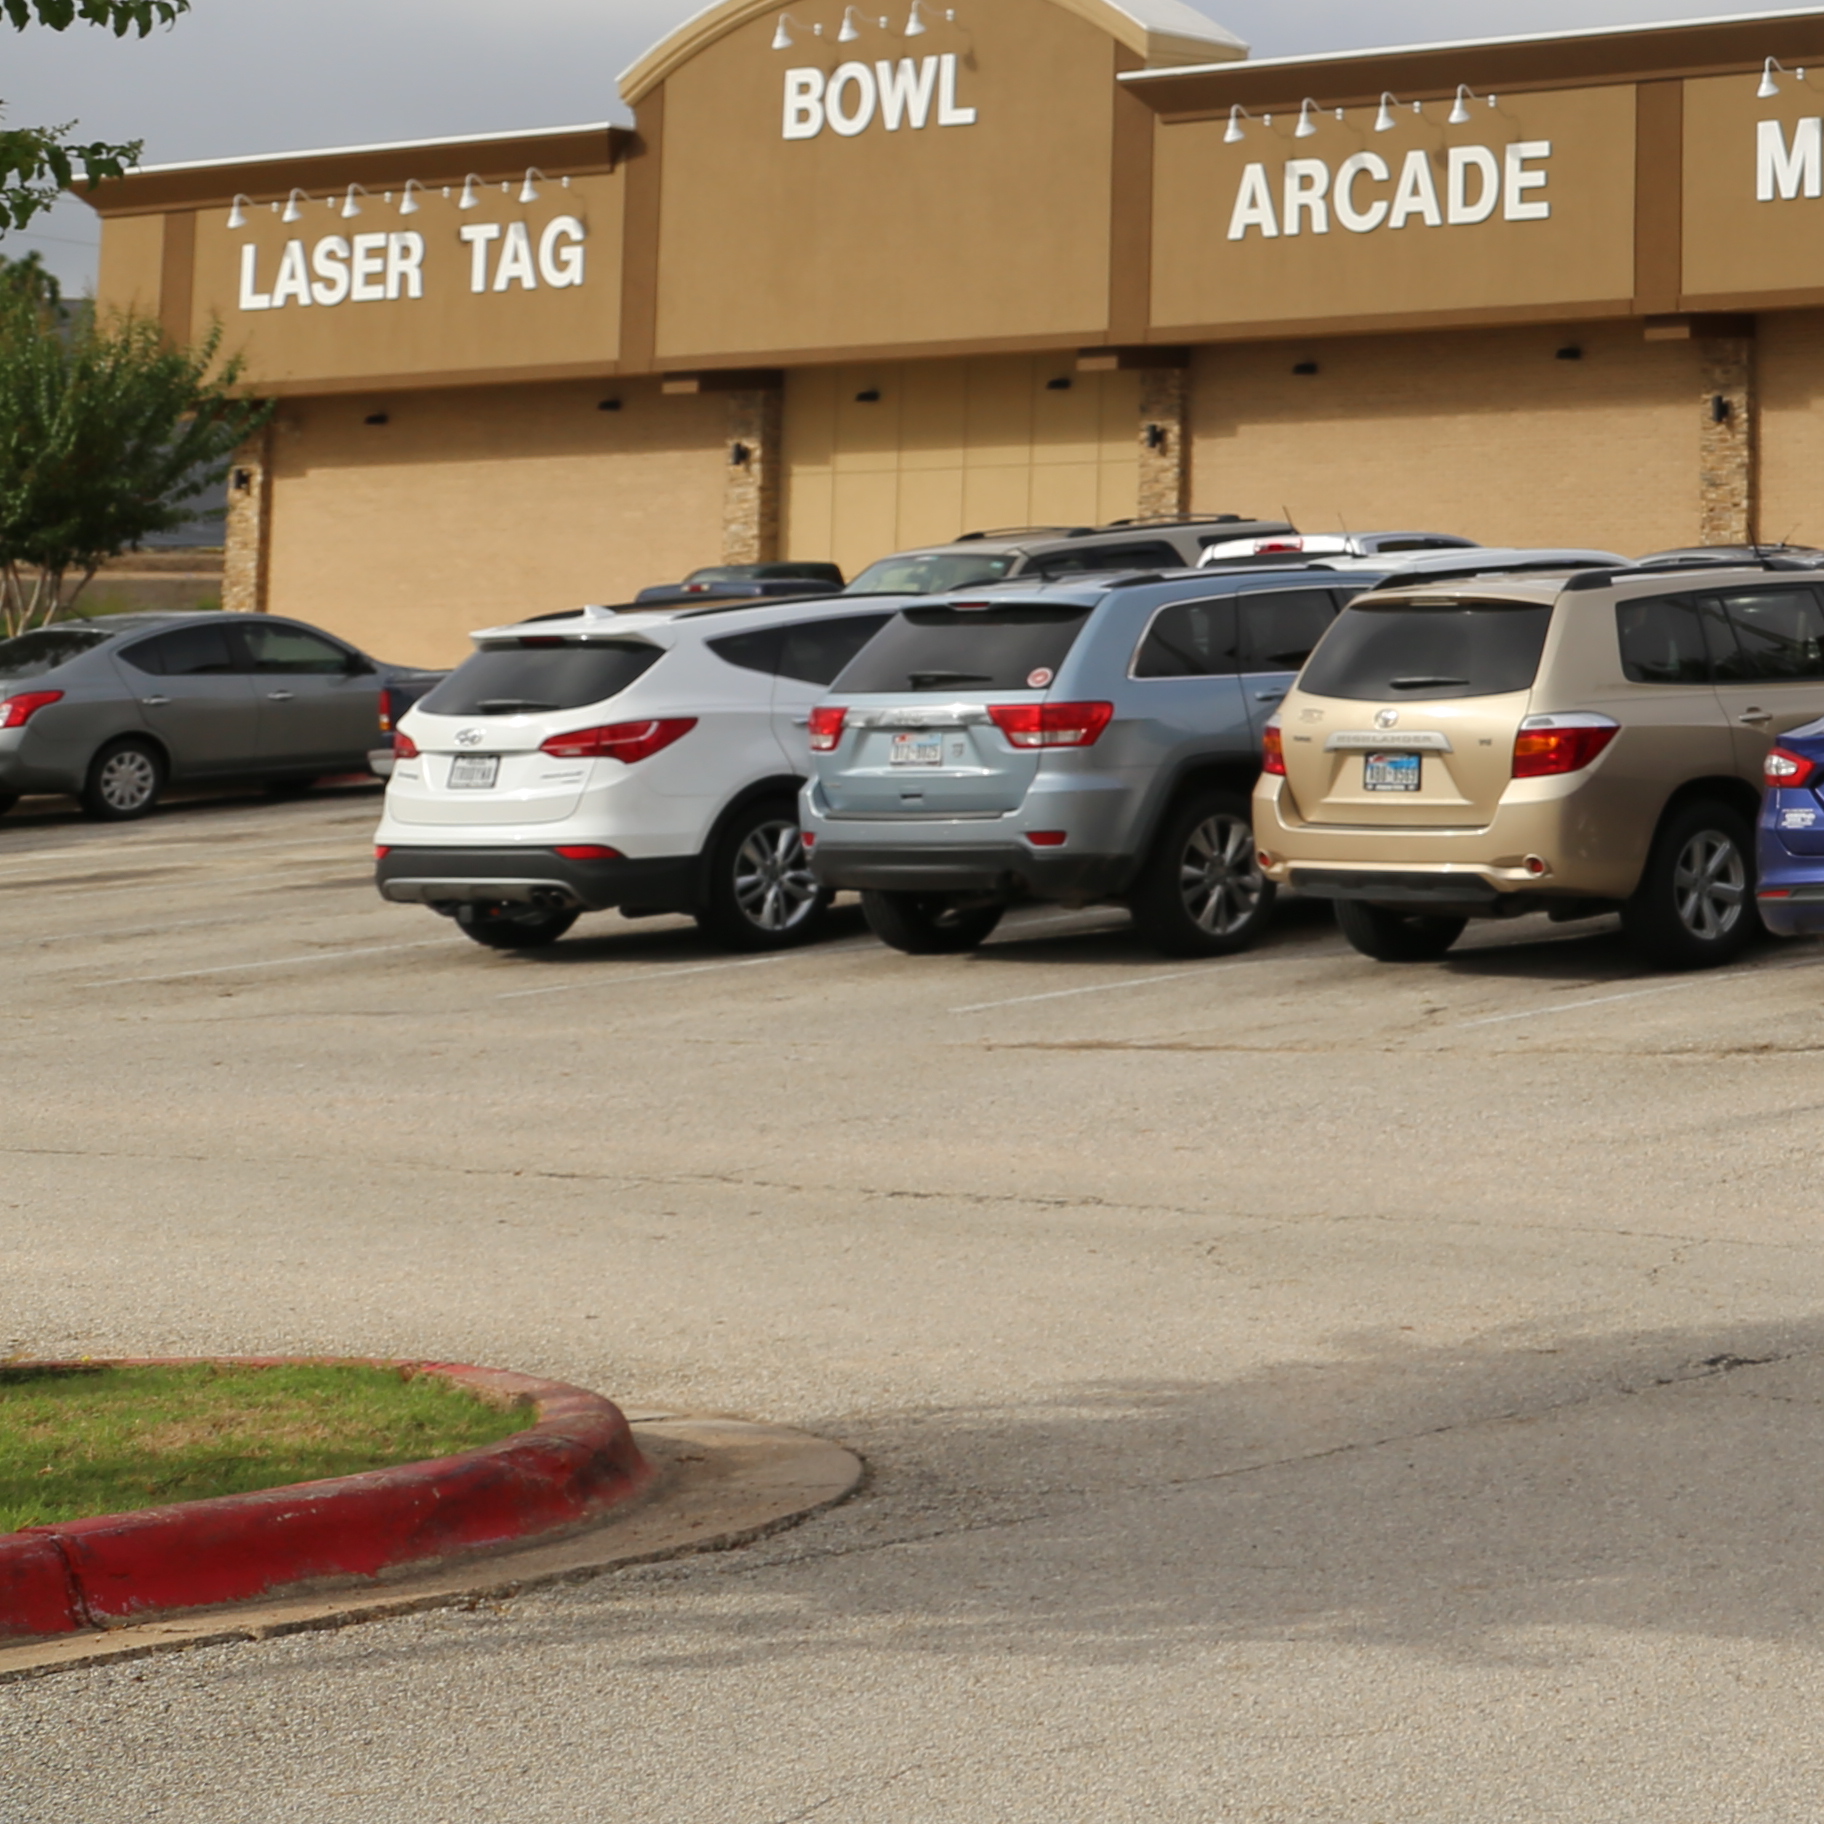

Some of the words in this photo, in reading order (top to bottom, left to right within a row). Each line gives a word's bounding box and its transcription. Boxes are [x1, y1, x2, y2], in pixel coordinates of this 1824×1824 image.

[781, 52, 977, 141] BOWL
[1226, 139, 1551, 241] ARCADE
[237, 229, 425, 312] LASER
[459, 214, 586, 293] TAG
